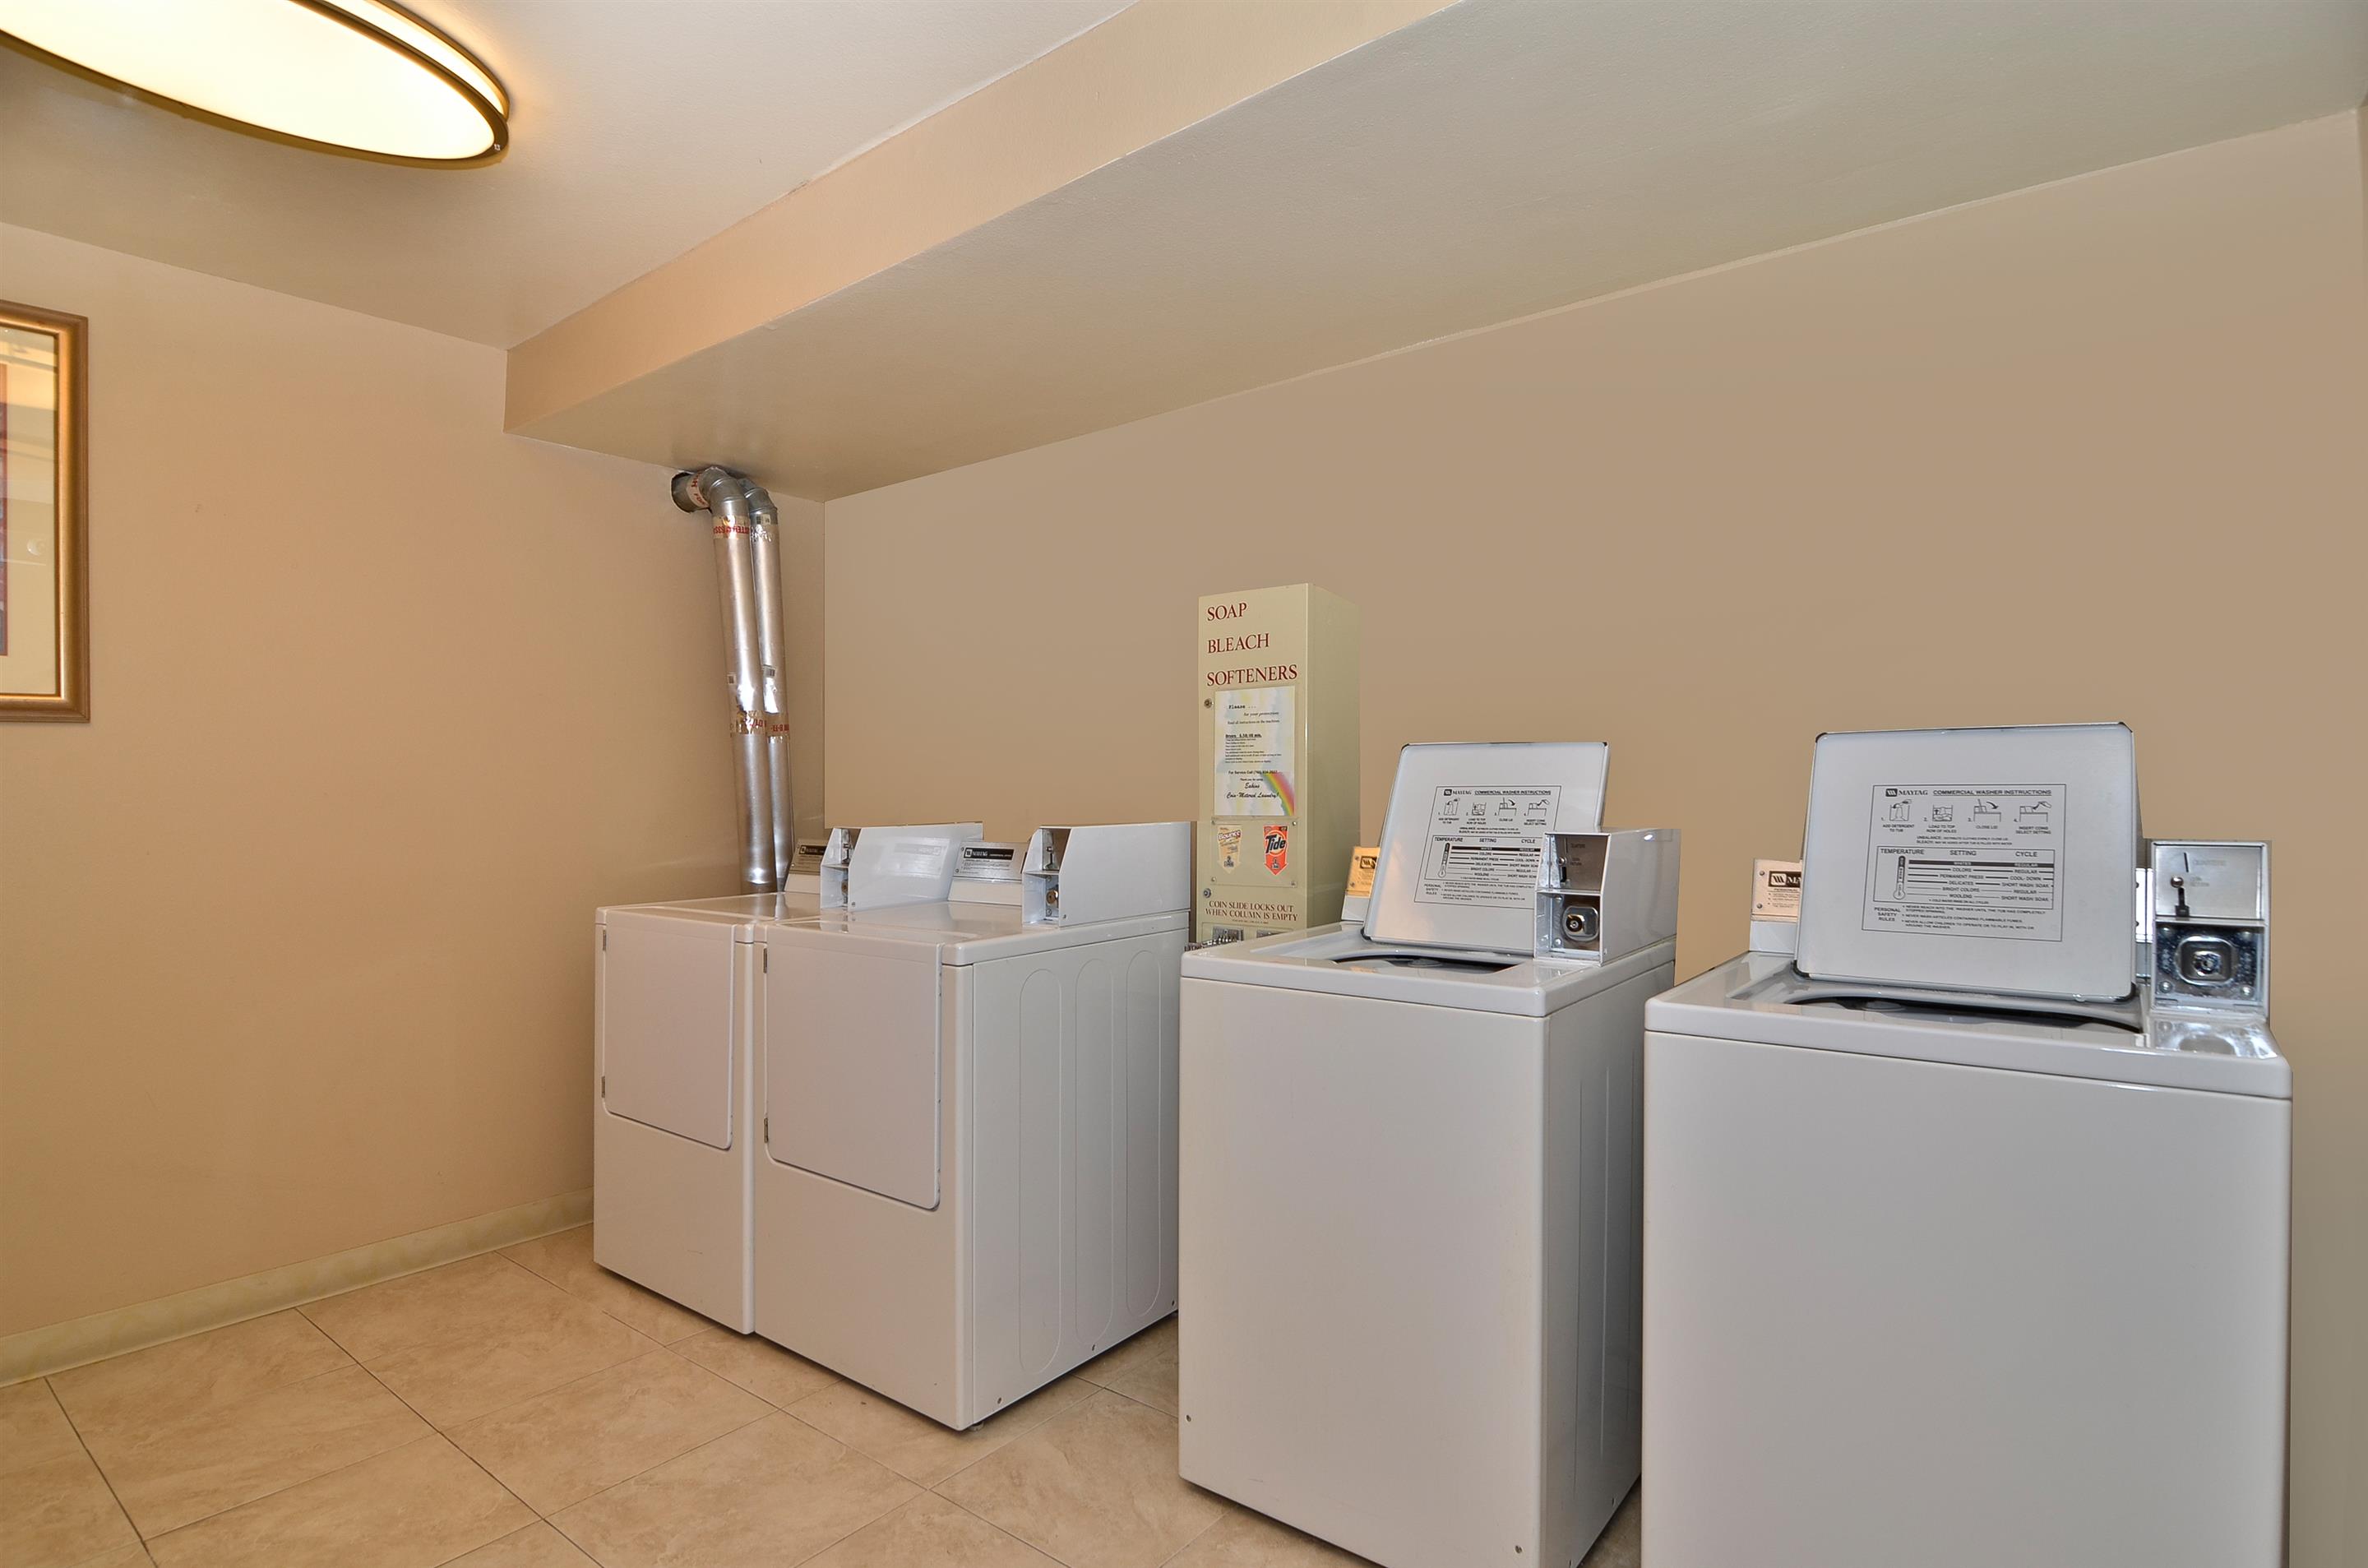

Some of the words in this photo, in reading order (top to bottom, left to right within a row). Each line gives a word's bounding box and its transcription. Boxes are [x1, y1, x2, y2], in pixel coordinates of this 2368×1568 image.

[1207, 603, 1247, 621] SOAP
[1208, 633, 1270, 654] BLEACH
[1206, 664, 1297, 687] SOFTENERS
[1265, 834, 1286, 854] Tide
[1229, 901, 1248, 909] SLIDE
[1250, 903, 1275, 911] LOCKS
[1277, 904, 1293, 913] OUT
[1229, 910, 1261, 918] COLUMN
[1272, 913, 1298, 921] EMPTY
